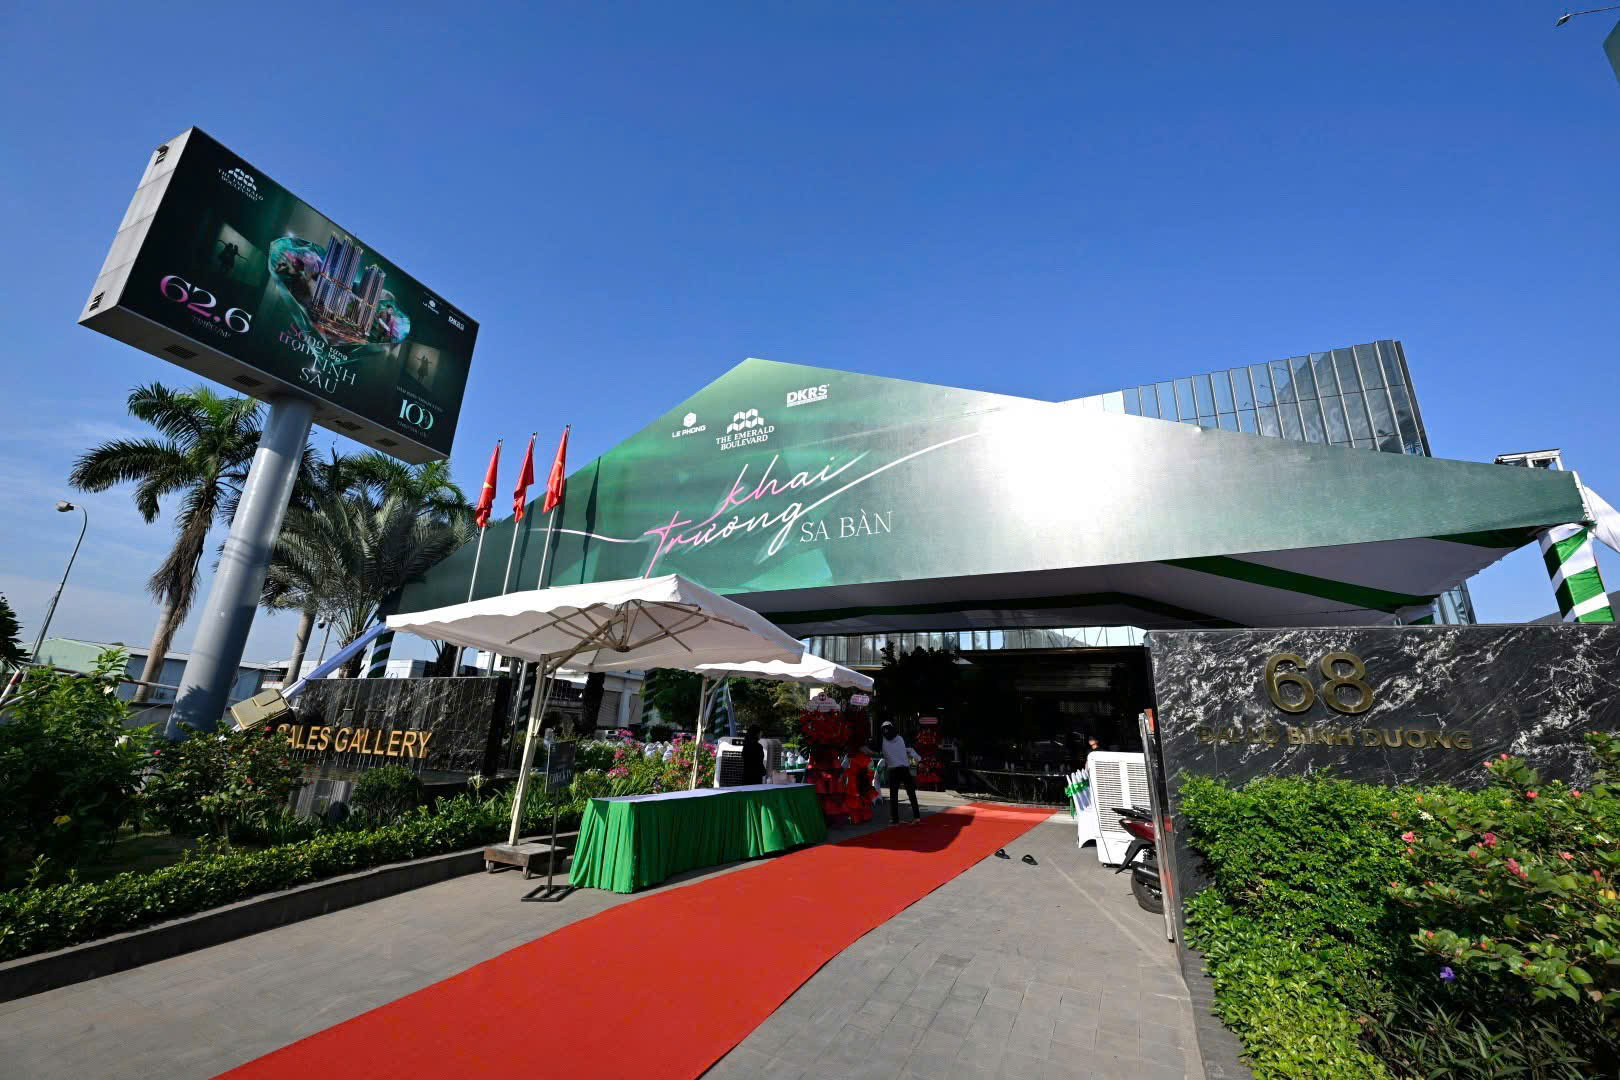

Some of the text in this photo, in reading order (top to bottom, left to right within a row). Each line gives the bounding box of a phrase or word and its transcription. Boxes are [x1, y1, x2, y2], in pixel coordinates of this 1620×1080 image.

[160, 275, 252, 333] 62.6
[787, 384, 829, 403] DKRS
[672, 424, 707, 438] LE PHONG
[716, 425, 775, 445] THE EMERALD
[720, 434, 769, 451] BOULEVARD
[705, 451, 870, 520] khai
[800, 509, 893, 543] SA BÀN
[1264, 652, 1374, 715] 68
[334, 727, 432, 759] GALLERY
